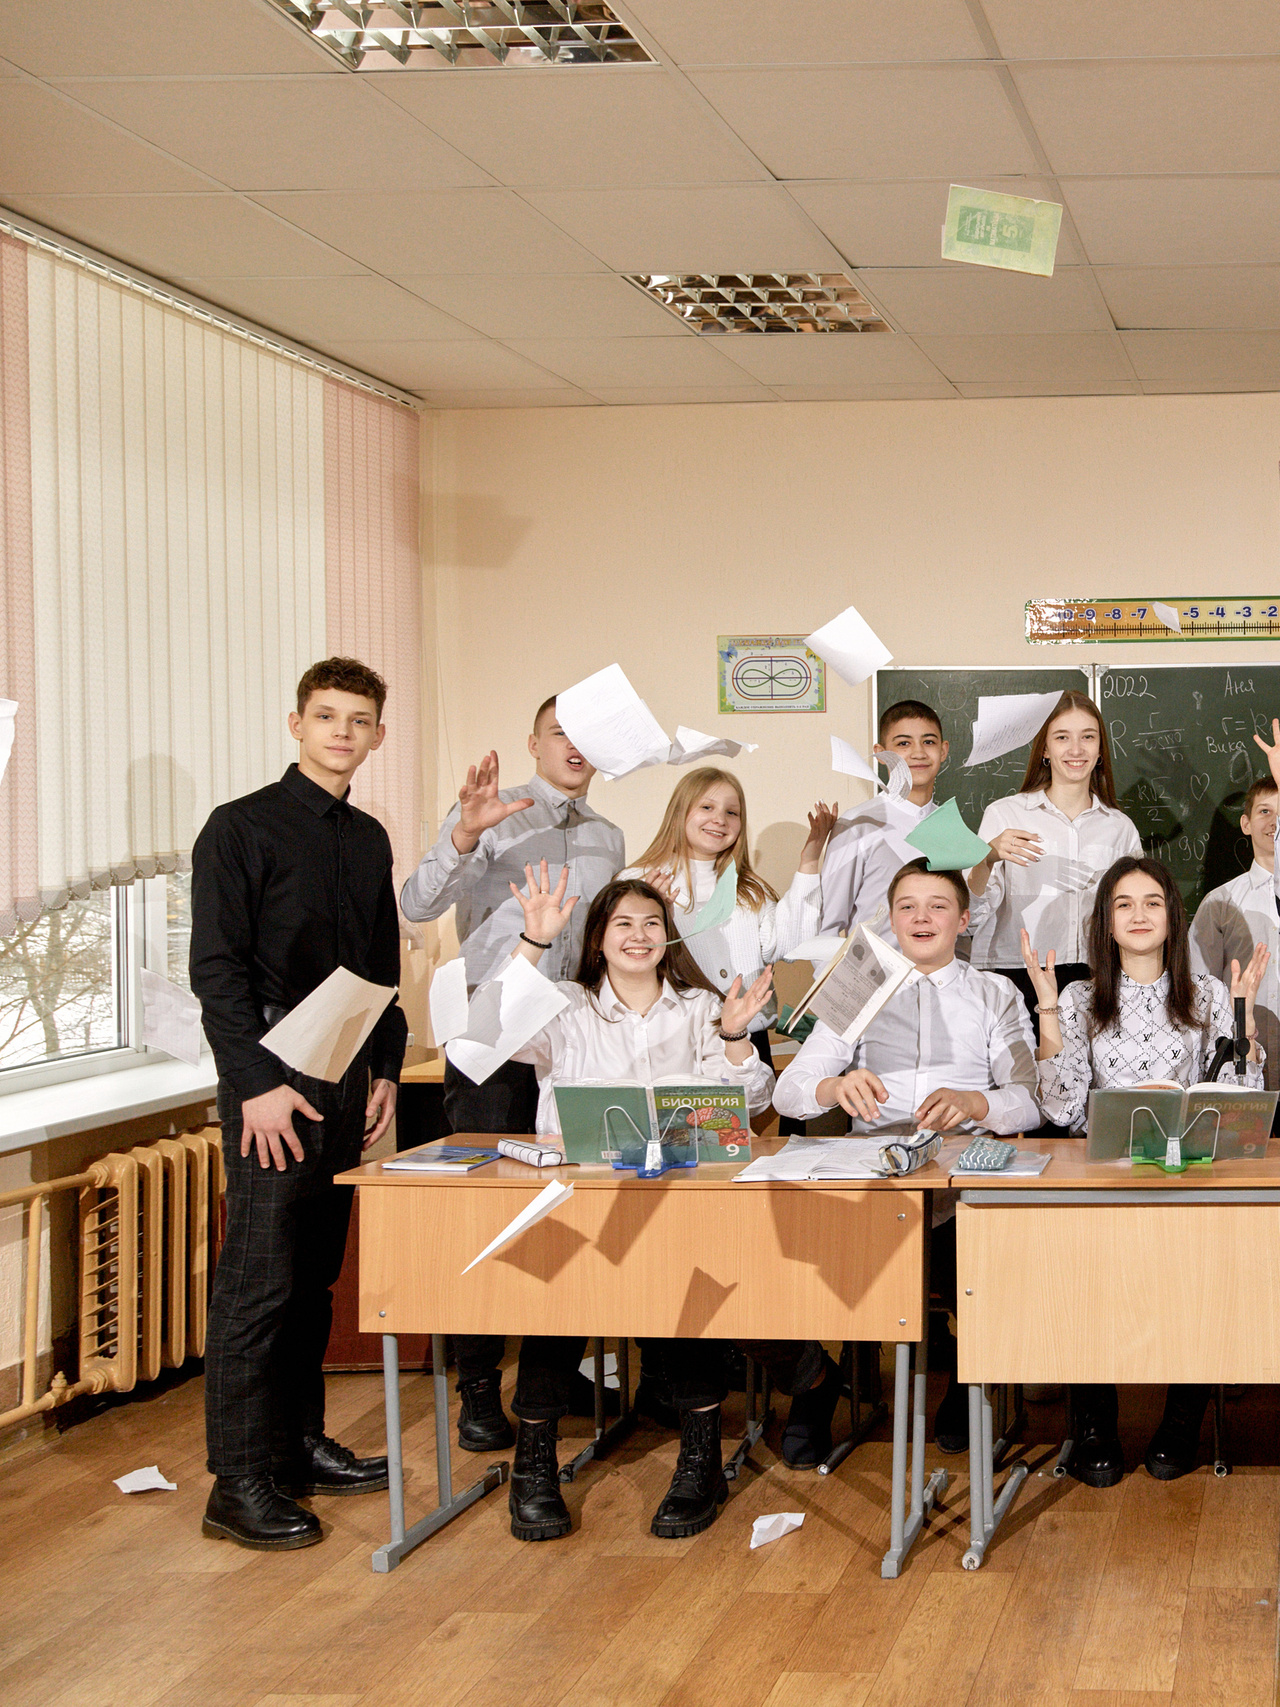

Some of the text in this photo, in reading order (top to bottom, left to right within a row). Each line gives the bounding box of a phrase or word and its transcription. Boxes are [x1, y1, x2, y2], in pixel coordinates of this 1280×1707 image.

[1078, 609, 1096, 620] -9
[1105, 608, 1122, 620] -8
[1131, 608, 1148, 619] -7
[1183, 607, 1200, 619] -5
[1208, 606, 1226, 618] -4
[1235, 606, 1252, 618] -3
[1260, 605, 1278, 617] -2
[1103, 674, 1157, 699] 2022
[1224, 671, 1255, 698] Аня
[1206, 736, 1247, 754] Вика
[1143, 832, 1172, 862] in
[661, 1097, 740, 1107] БИОЛОГИЯ
[1193, 1102, 1268, 1112] БИОЛОГИЯ
[725, 1143, 740, 1157] 9
[1243, 1143, 1256, 1154] 9
